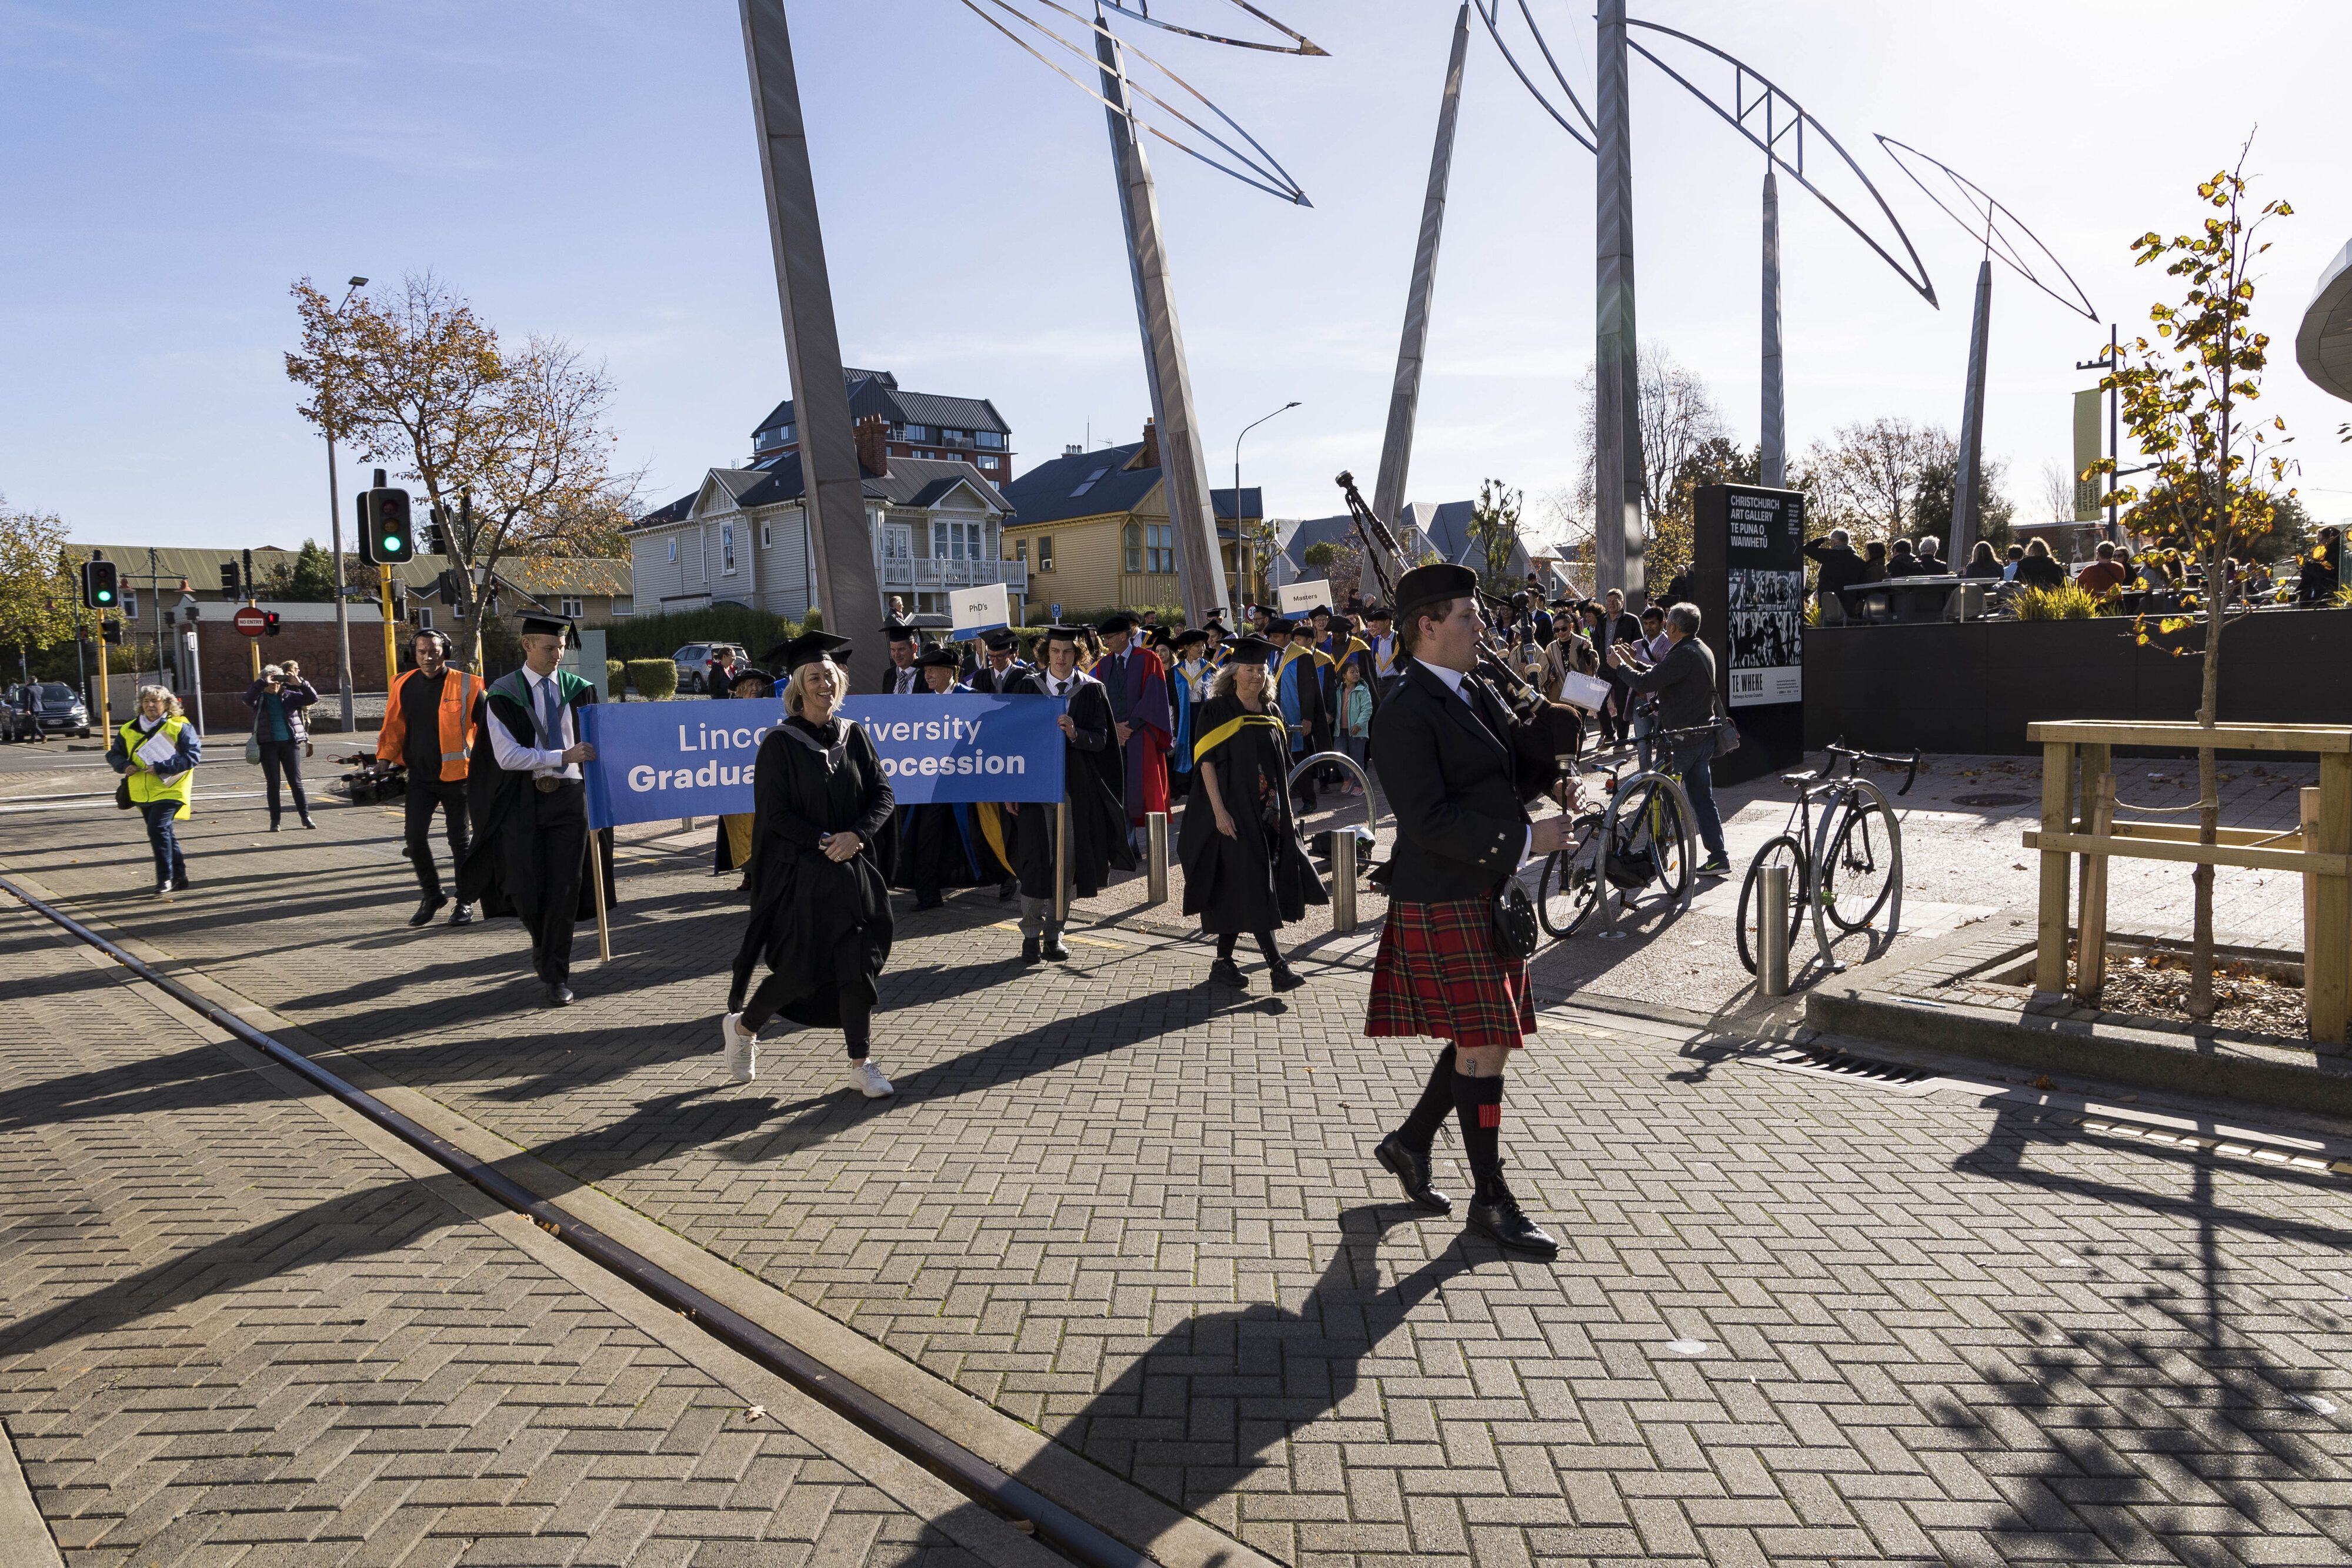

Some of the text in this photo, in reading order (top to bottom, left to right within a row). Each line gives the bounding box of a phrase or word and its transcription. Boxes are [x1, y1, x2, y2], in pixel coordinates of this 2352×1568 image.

[1730, 495, 1780, 510] CHRISTCHURCH
[1730, 508, 1773, 522] ART GALLERY
[1730, 522, 1764, 535] TE PUNA O
[1730, 535, 1767, 548] WAIWHETŪ
[969, 603, 988, 612] PhD's
[1571, 671, 1609, 687] WITCHERY
[1732, 675, 1739, 693] TE
[1741, 673, 1763, 692] WHEKE
[679, 714, 982, 752] Linc iversity
[628, 749, 1025, 792] Gradua ocession
